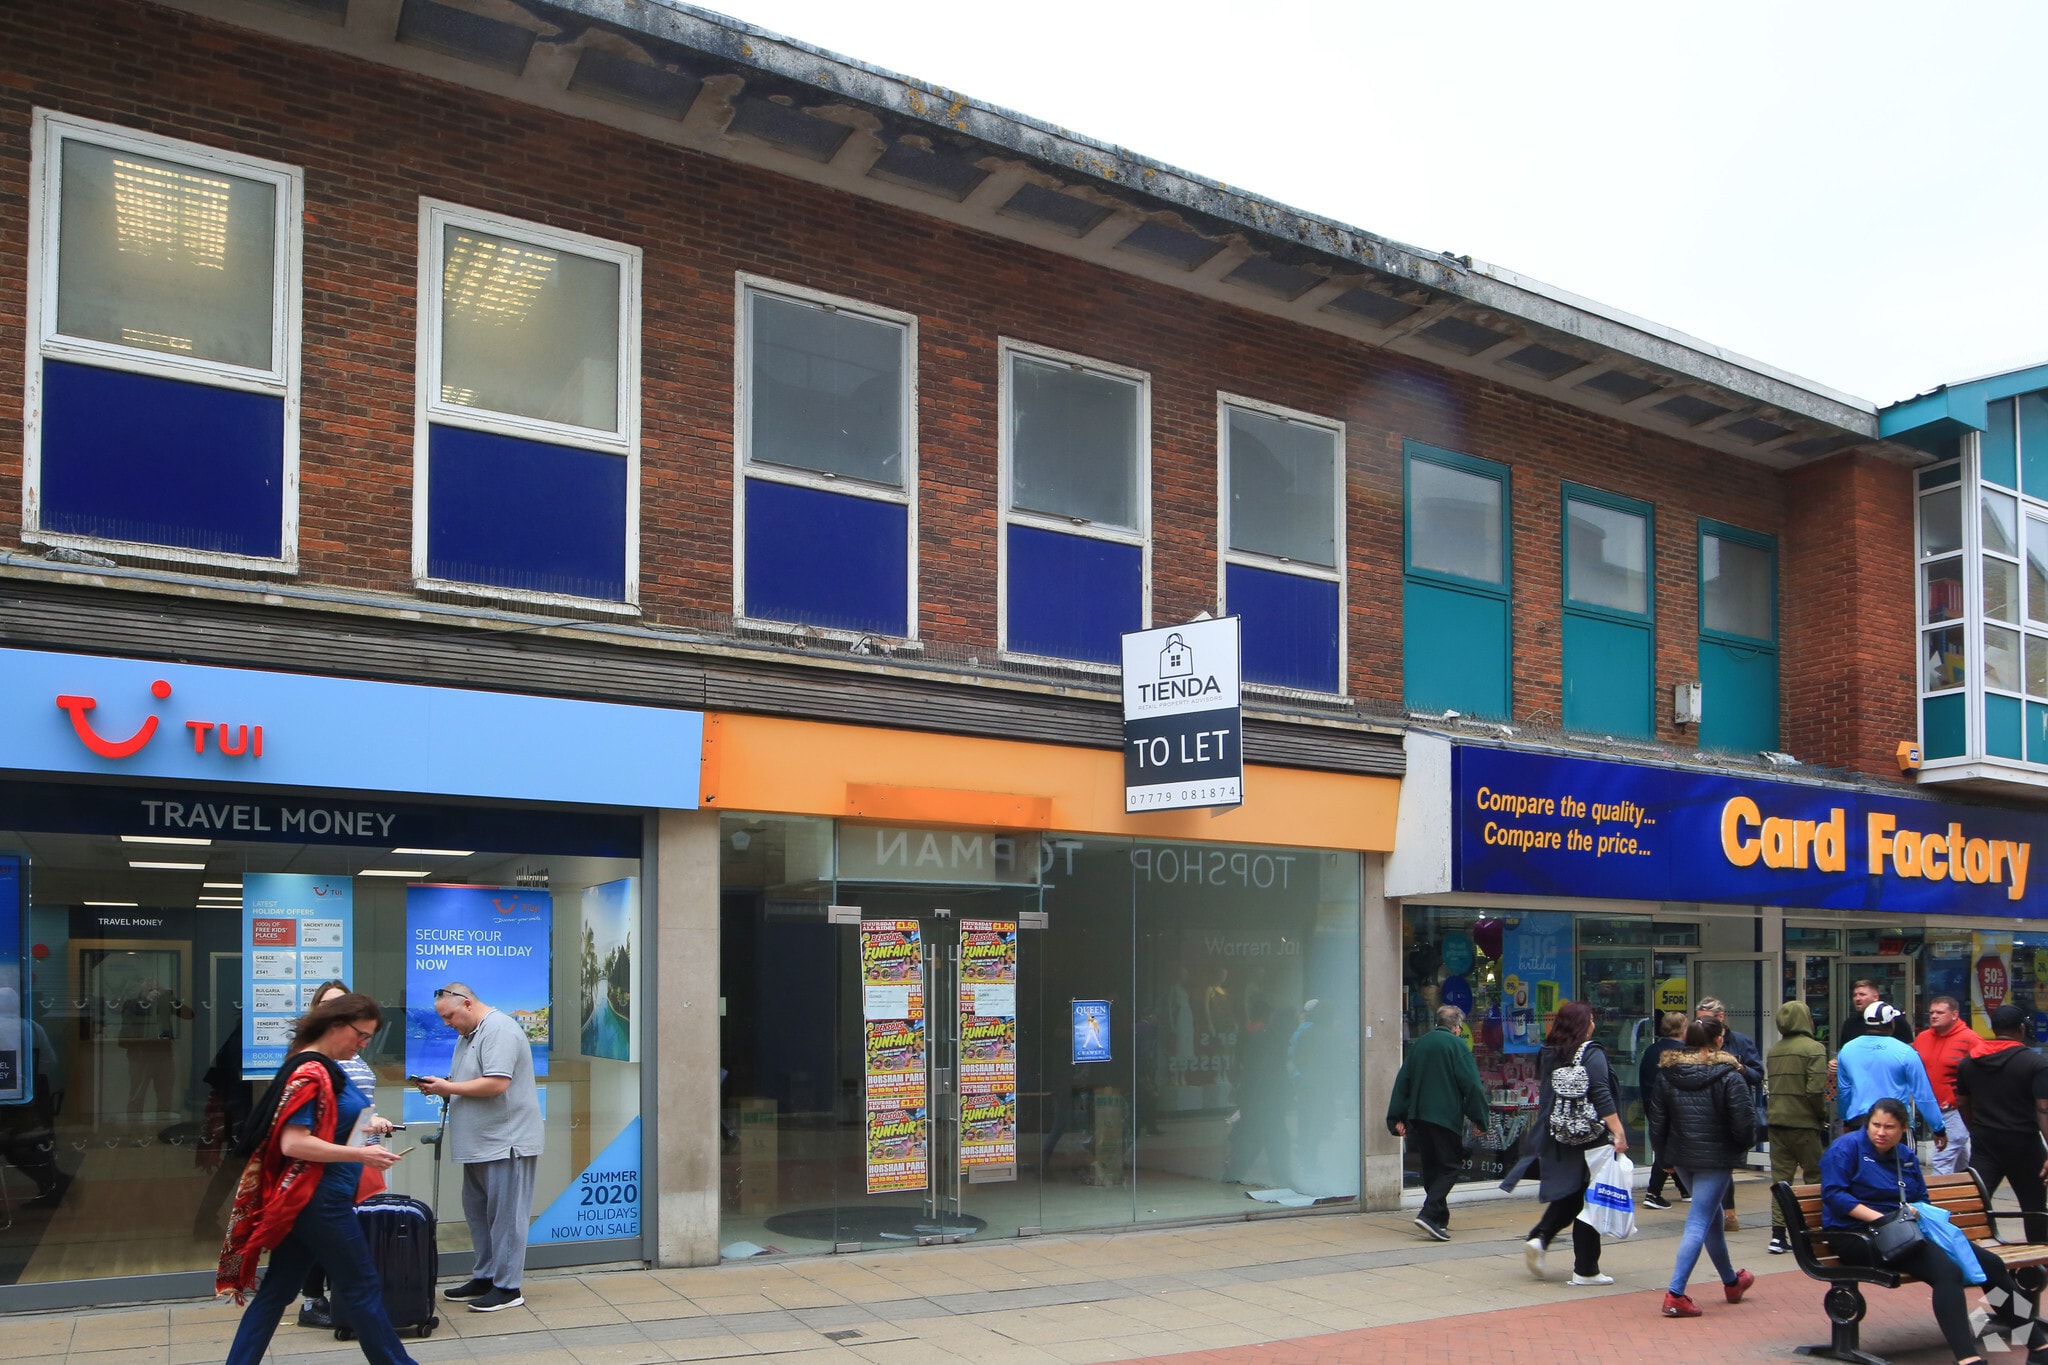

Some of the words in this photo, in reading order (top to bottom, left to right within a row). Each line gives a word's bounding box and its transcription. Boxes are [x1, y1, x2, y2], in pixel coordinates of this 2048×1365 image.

[1138, 675, 1221, 703] TIENDA
[1159, 700, 1190, 708] PROPERTY
[1191, 695, 1223, 704] ADVISORS
[185, 720, 263, 757] TUI
[1133, 736, 1170, 768] TO
[1181, 729, 1230, 763] LET
[1130, 791, 1172, 805] 07779
[1181, 786, 1236, 801] 081874
[1477, 786, 1555, 818] Compare
[1560, 795, 1586, 819] the
[1591, 800, 1656, 829] quality...
[141, 800, 271, 831] TRAVEL
[281, 806, 396, 837] MONEY
[1483, 821, 1561, 853] Compare
[1567, 829, 1593, 852] the
[1597, 832, 1651, 858] price...
[1721, 796, 1845, 872] Card
[1867, 811, 2031, 900] Factory
[286, 908, 315, 916] OFFERS
[521, 904, 539, 913] TUI
[98, 917, 131, 926] TRAVEL
[132, 918, 164, 926] MONEY
[992, 922, 1014, 930] £1.50
[415, 928, 465, 941] SECURE
[467, 930, 502, 941] YOUR
[970, 932, 998, 941] BENSONS
[415, 944, 473, 956] SUMMER
[476, 945, 533, 957] HOLIDAY
[864, 943, 913, 960] FUNFAIR
[962, 944, 1007, 958] FUNFAIR
[1204, 935, 1271, 957] Warren
[1519, 935, 1558, 958] BIG
[416, 959, 448, 970] NOW
[1518, 956, 1557, 979] birthday
[1662, 991, 1669, 1005] 5
[1669, 996, 1684, 1005] FOR
[1983, 986, 2003, 999] SALE
[1076, 1005, 1106, 1016] QUEEN
[962, 1024, 1007, 1039] FUNFAIR
[867, 1032, 915, 1050] FUNFAIR
[961, 1064, 995, 1072] HORSHAM
[996, 1064, 1014, 1072] PARK
[867, 1074, 904, 1084] HORSHAM
[904, 1073, 924, 1082] PARK
[900, 1099, 924, 1107] £1.50
[961, 1105, 1006, 1121] FUNFAIR
[869, 1121, 917, 1139] FUNFAIR
[960, 1145, 995, 1155] HORSHAM
[995, 1144, 1014, 1153] PARK
[868, 1162, 905, 1173] HORSHAM
[906, 1161, 926, 1170] PARK
[1481, 1160, 1503, 1173] £1.29
[582, 1170, 637, 1184] SUMMER
[580, 1184, 638, 1206] 2020
[577, 1207, 638, 1221] HOLIDAYS
[551, 1226, 582, 1239] NOW
[585, 1224, 604, 1236] ON
[607, 1222, 638, 1235] SALE
